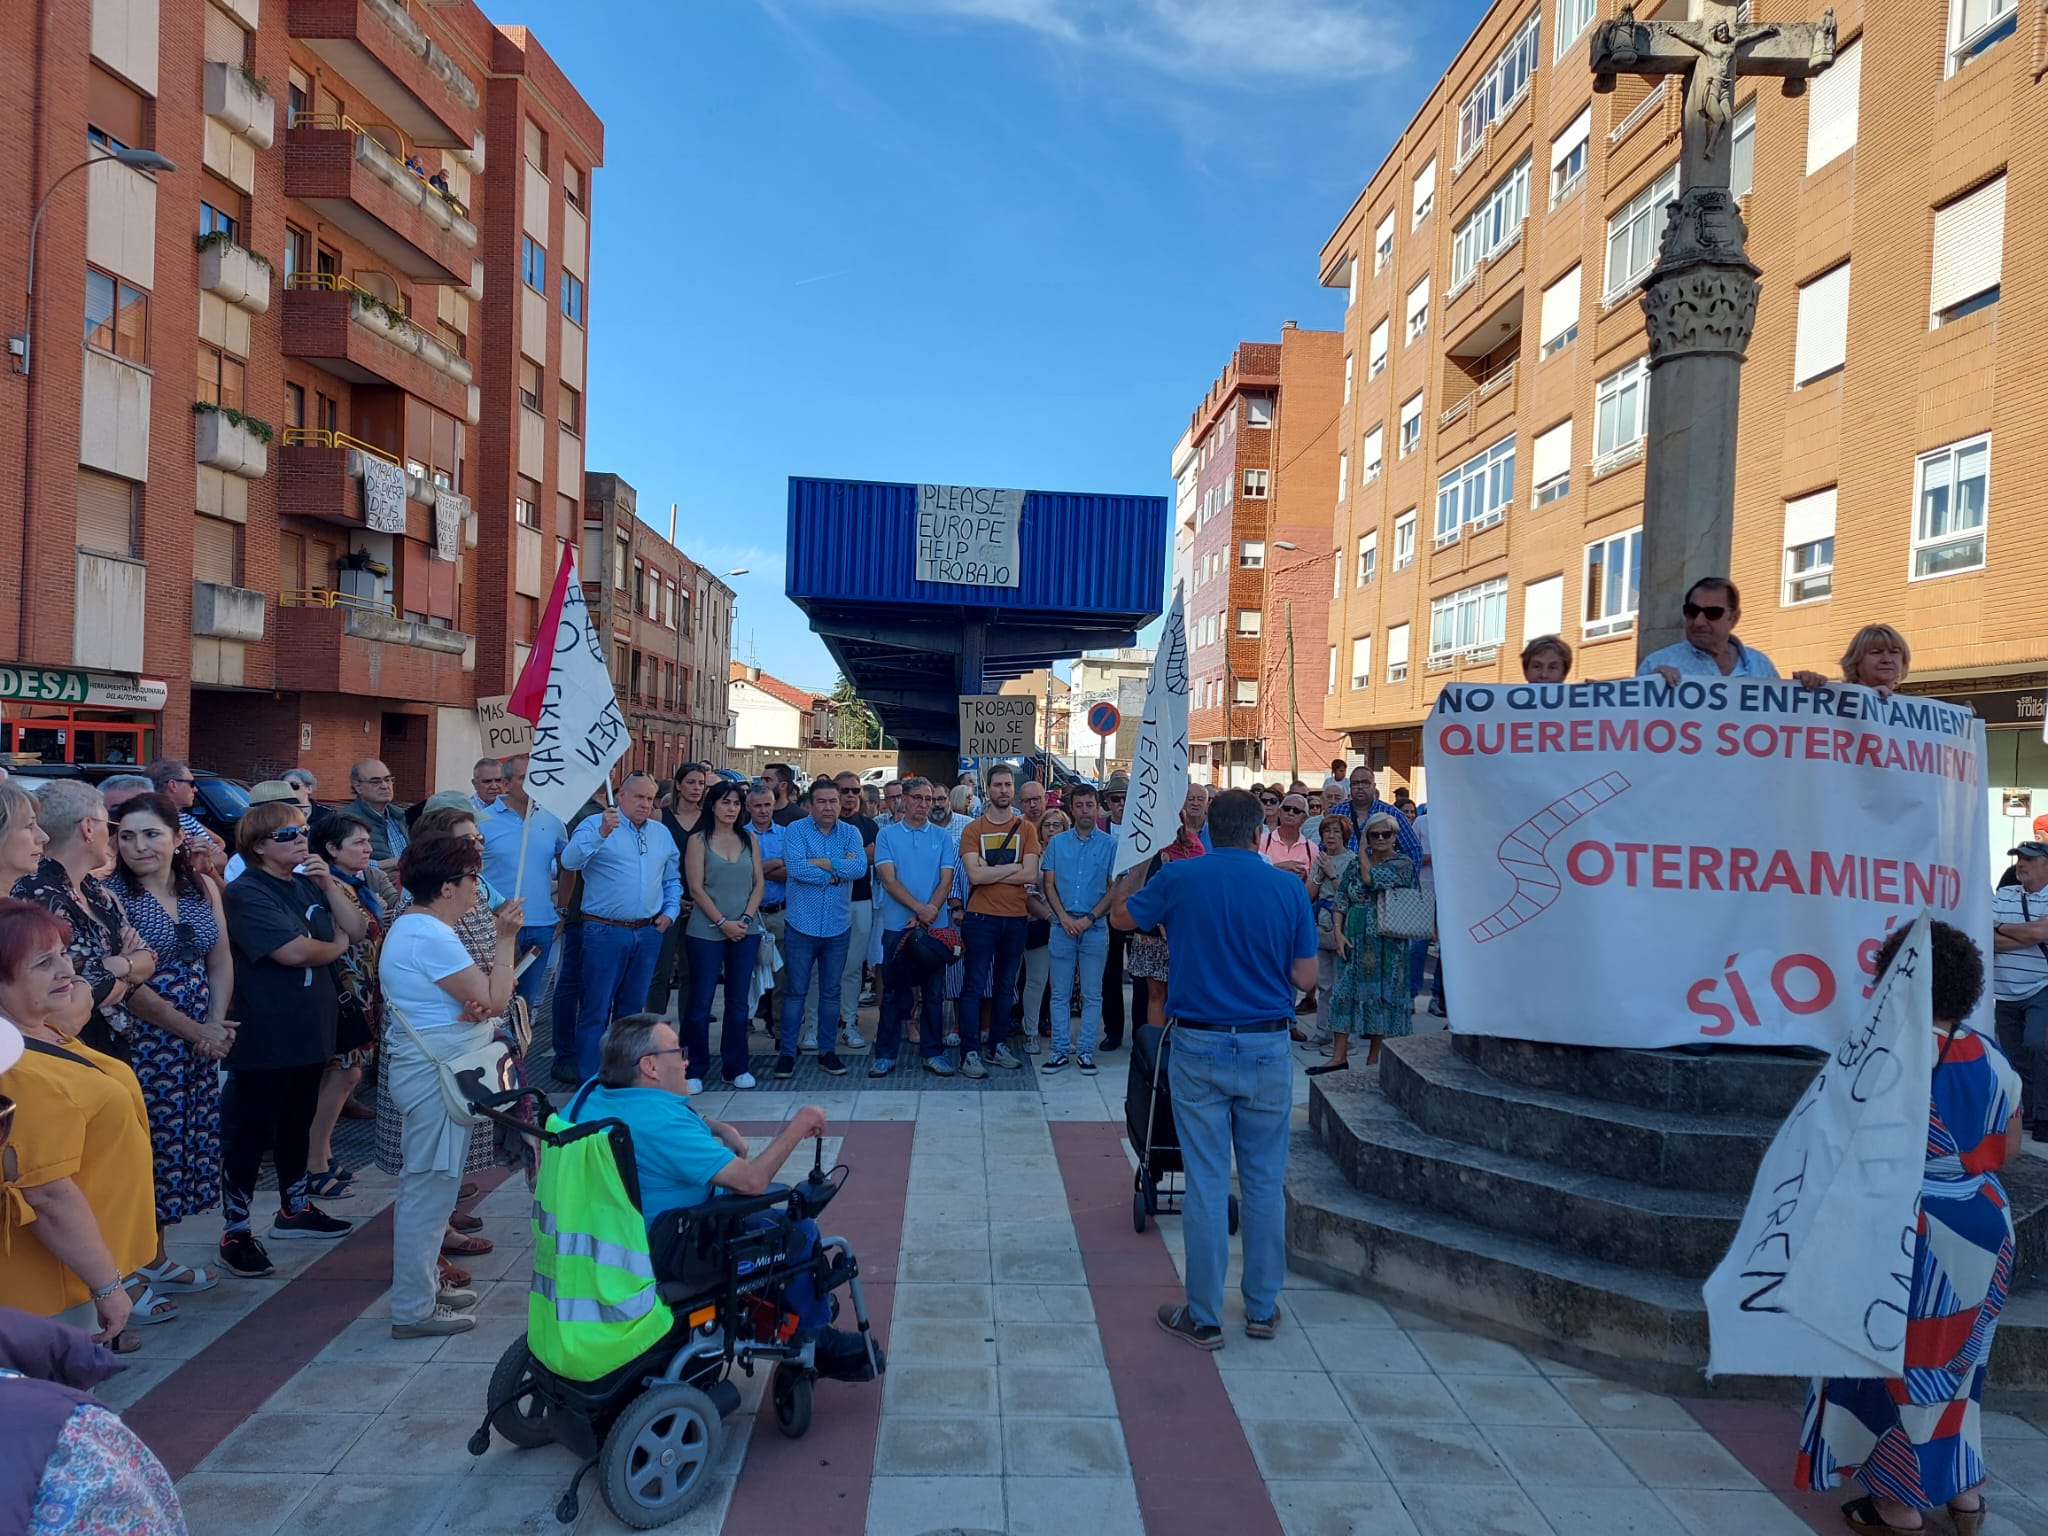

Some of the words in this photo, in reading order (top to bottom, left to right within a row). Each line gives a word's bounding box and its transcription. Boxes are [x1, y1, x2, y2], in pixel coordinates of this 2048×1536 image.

[920, 513, 1005, 544] EUROPE
[920, 541, 969, 560] HELP
[926, 560, 1010, 584] TROBAJO
[0, 669, 82, 701] DESA
[1439, 687, 1496, 714] NO
[1507, 680, 1728, 710] QUEREMOS
[2021, 696, 2032, 704] san
[480, 703, 504, 723] MAS
[961, 701, 1035, 718] TROBAJO
[974, 720, 995, 735] NO
[1006, 720, 1024, 733] SE
[969, 738, 1023, 755] RINDE
[1439, 720, 1703, 756] QUEREMOS
[1686, 953, 1761, 1037] SÍ
[1771, 954, 1837, 1015] O
[755, 1252, 786, 1267] Misral
